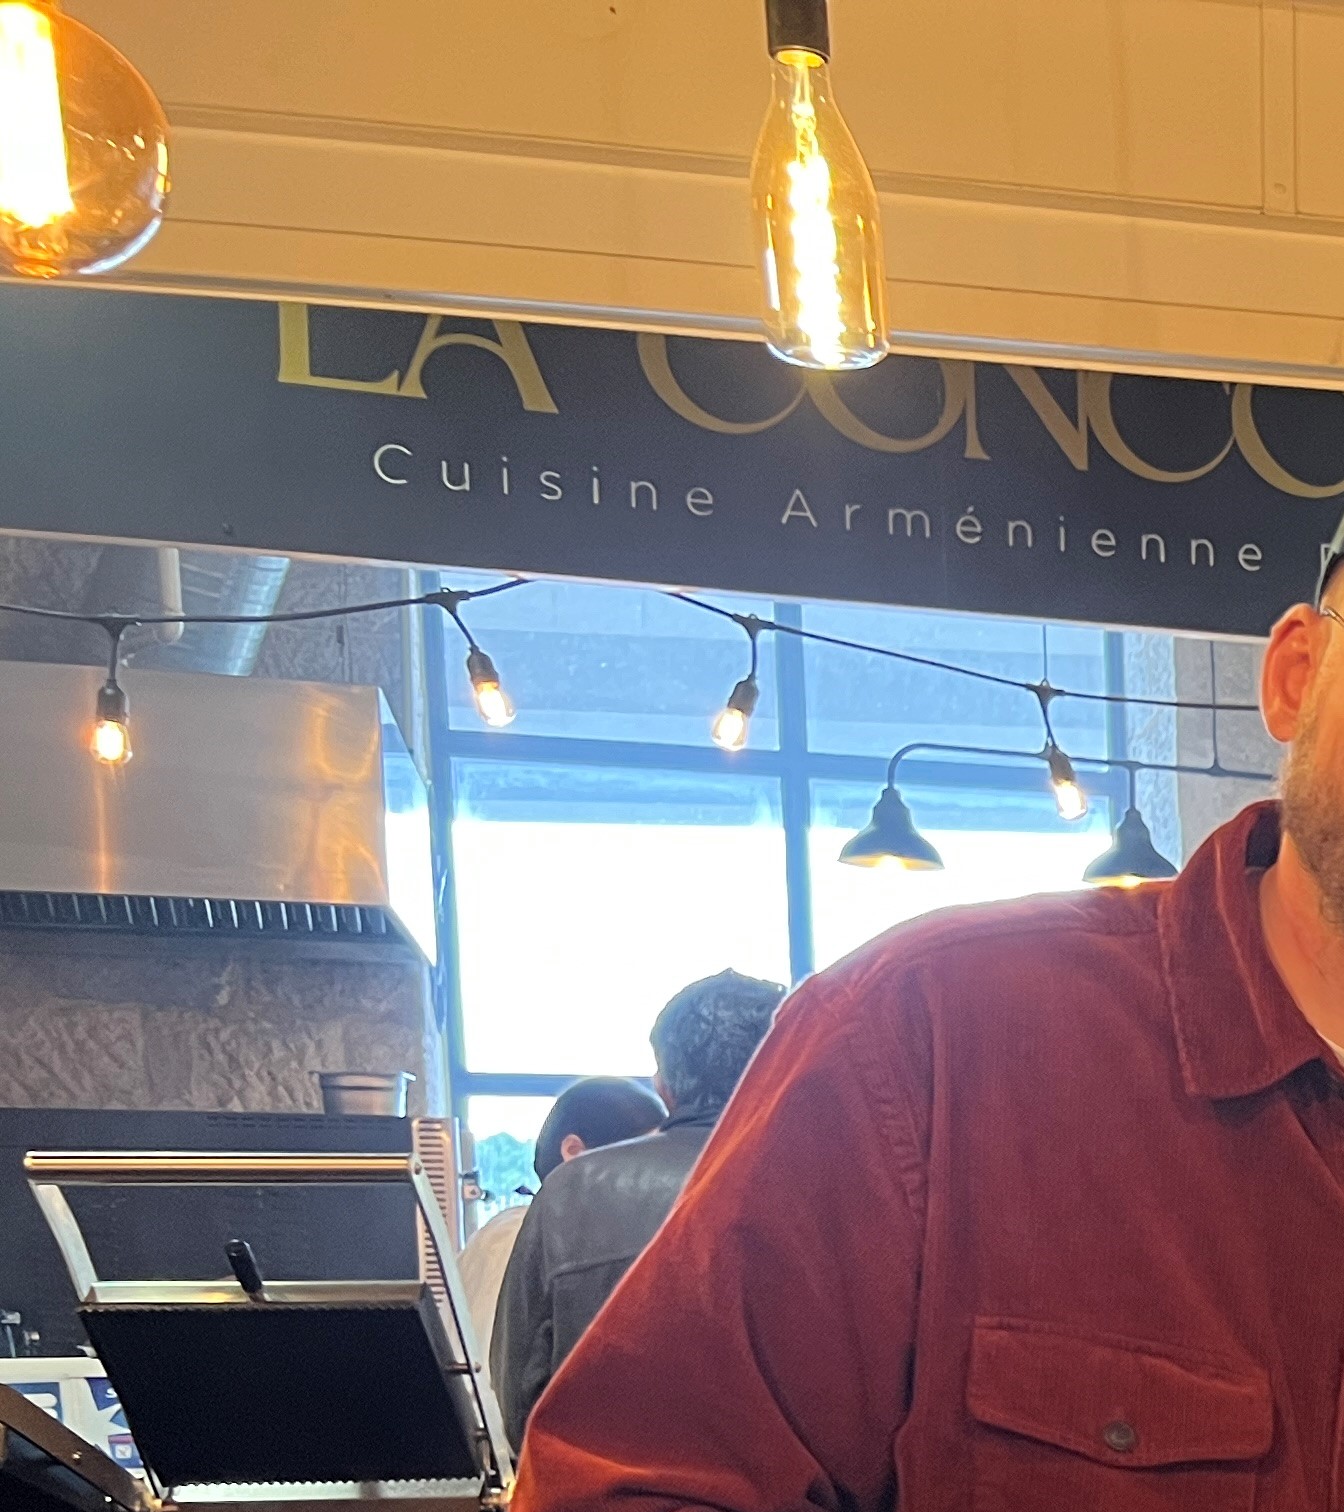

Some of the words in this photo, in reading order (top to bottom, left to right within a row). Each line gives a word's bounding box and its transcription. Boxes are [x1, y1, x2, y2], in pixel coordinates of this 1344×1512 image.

[278, 302, 559, 414] LA
[373, 443, 714, 517] Cuisine
[780, 487, 1264, 573] Arménienne
